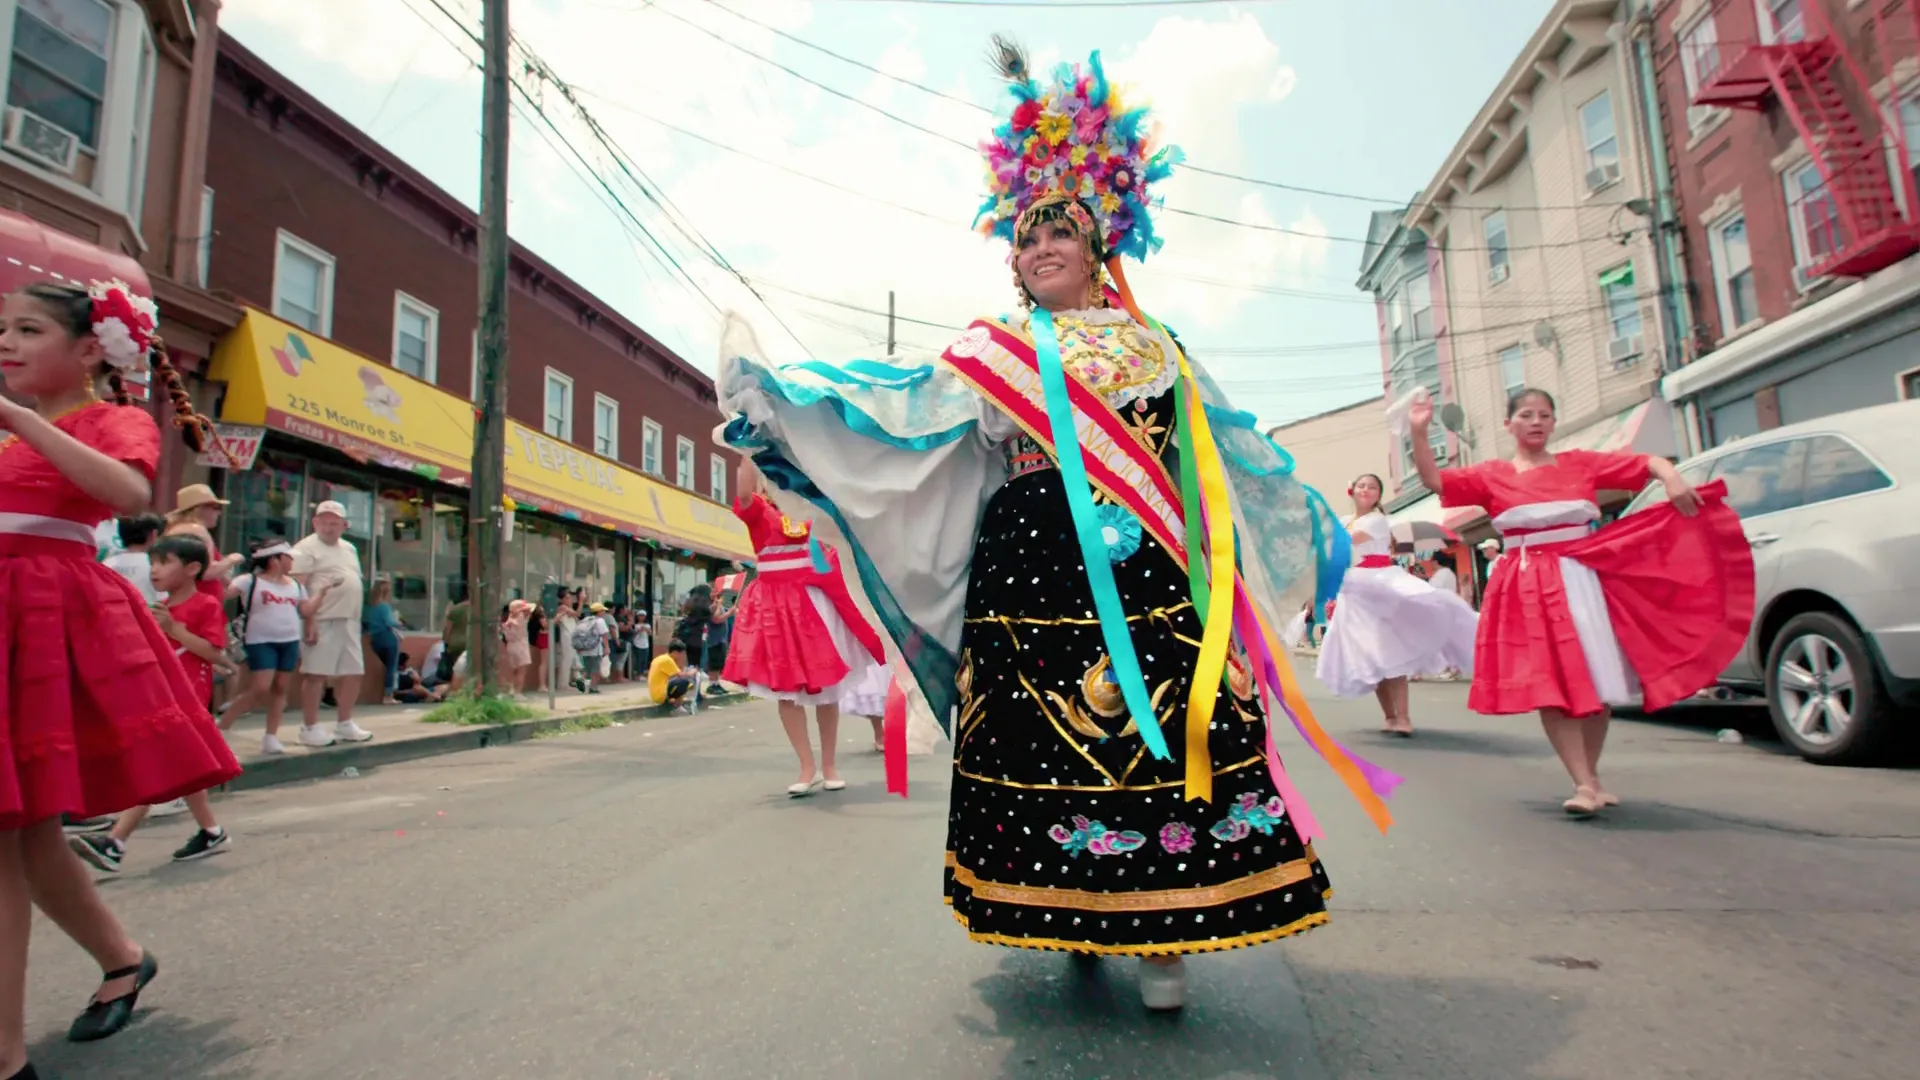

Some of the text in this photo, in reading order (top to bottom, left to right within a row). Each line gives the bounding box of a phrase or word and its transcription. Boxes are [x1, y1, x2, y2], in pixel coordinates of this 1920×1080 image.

[284, 415, 324, 440] Frutas
[286, 393, 321, 416] 225
[325, 407, 386, 439] Monroe
